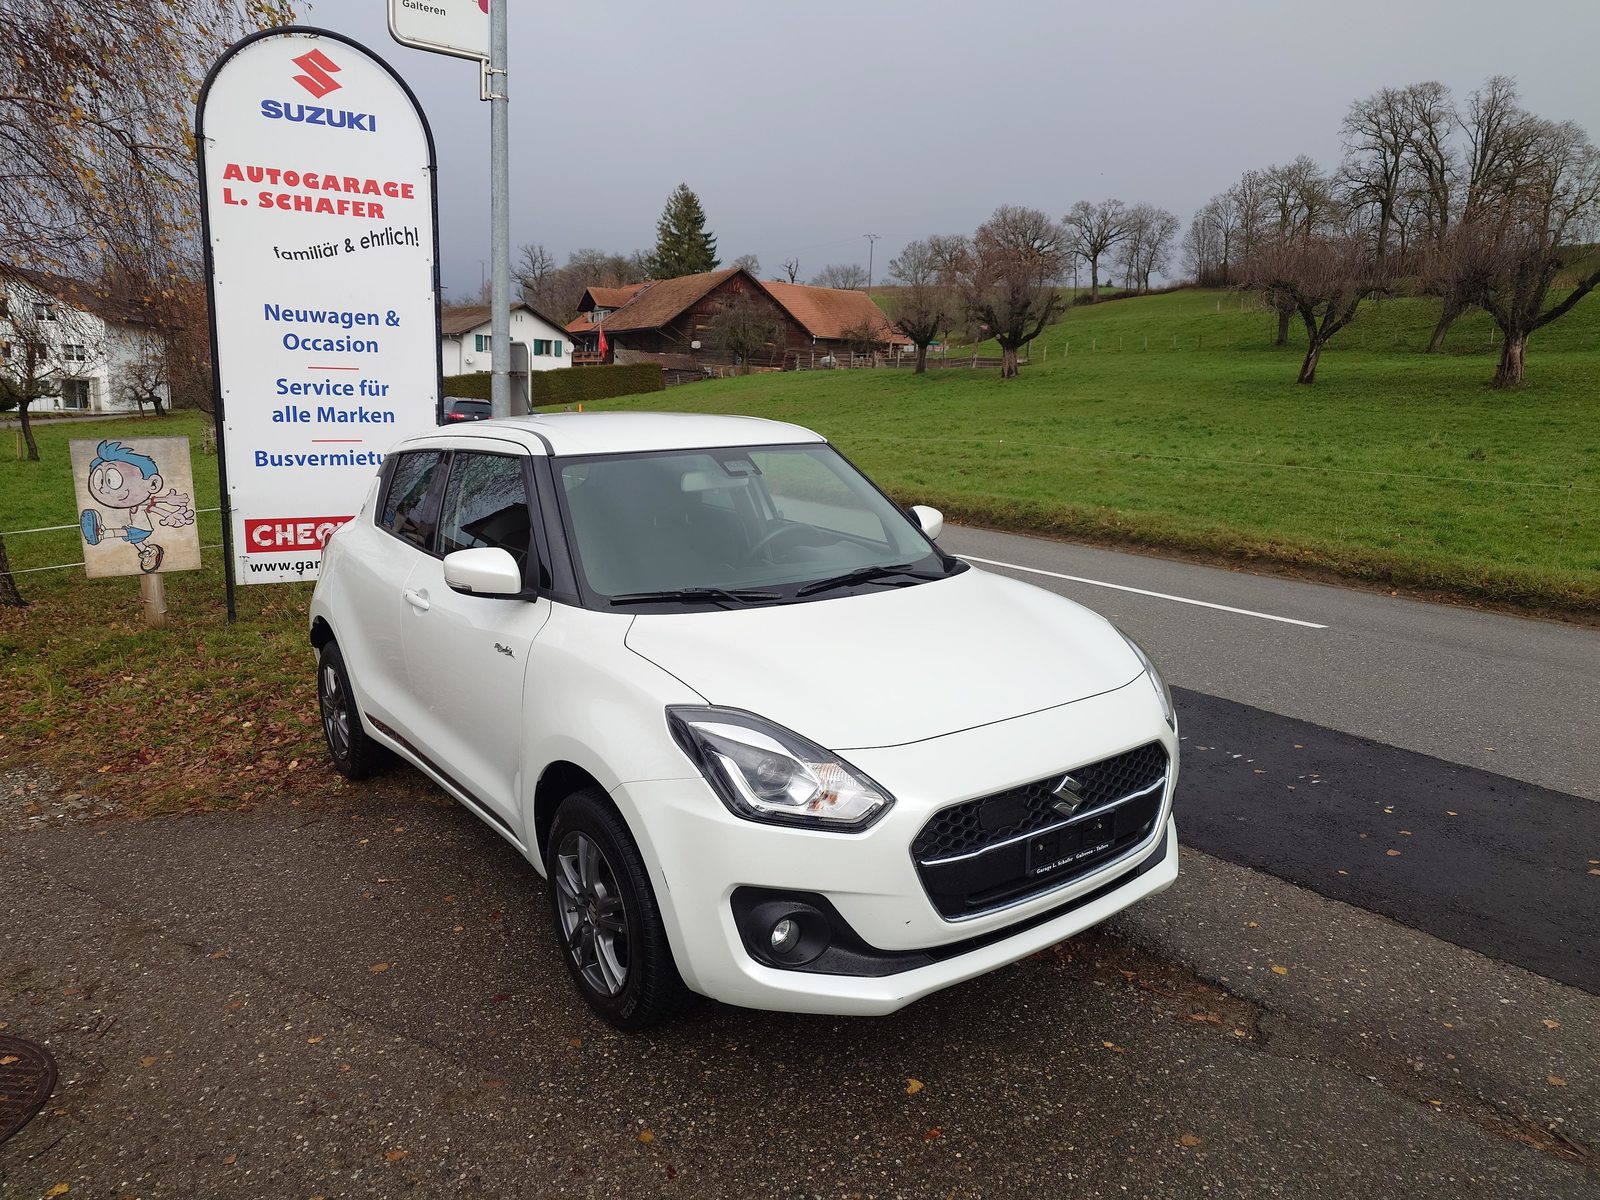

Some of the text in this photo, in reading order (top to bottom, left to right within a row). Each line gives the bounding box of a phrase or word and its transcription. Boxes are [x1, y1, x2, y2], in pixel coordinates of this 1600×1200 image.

[402, 0, 446, 16] Galteren
[261, 99, 376, 132] SUZUKI
[223, 163, 415, 200] AUTOGARAGE
[223, 187, 385, 220] L. SCHAFER
[273, 226, 420, 261] familiär & ehrlich!
[264, 303, 400, 329] Neuwagen &
[282, 333, 379, 353] Occasion
[276, 378, 389, 397] Service für
[272, 405, 395, 423] alle Marken
[250, 559, 321, 575] www.gar
